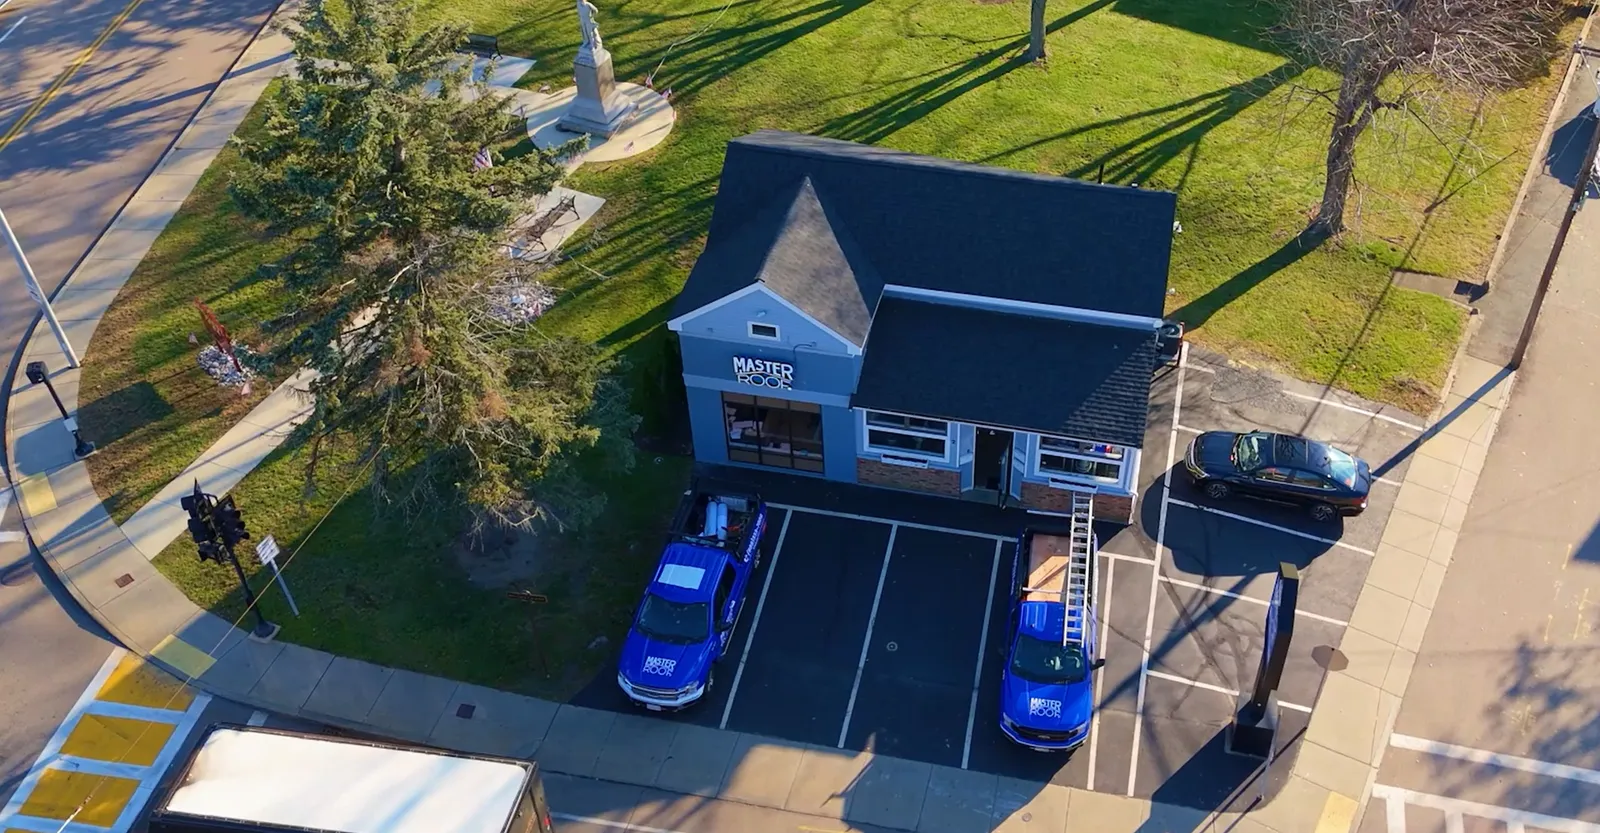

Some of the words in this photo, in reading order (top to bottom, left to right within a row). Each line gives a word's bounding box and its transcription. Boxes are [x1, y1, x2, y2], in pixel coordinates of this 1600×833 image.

[733, 356, 793, 380] MASTER
[645, 656, 676, 672] MASTER
[1030, 697, 1062, 711] MASTER
